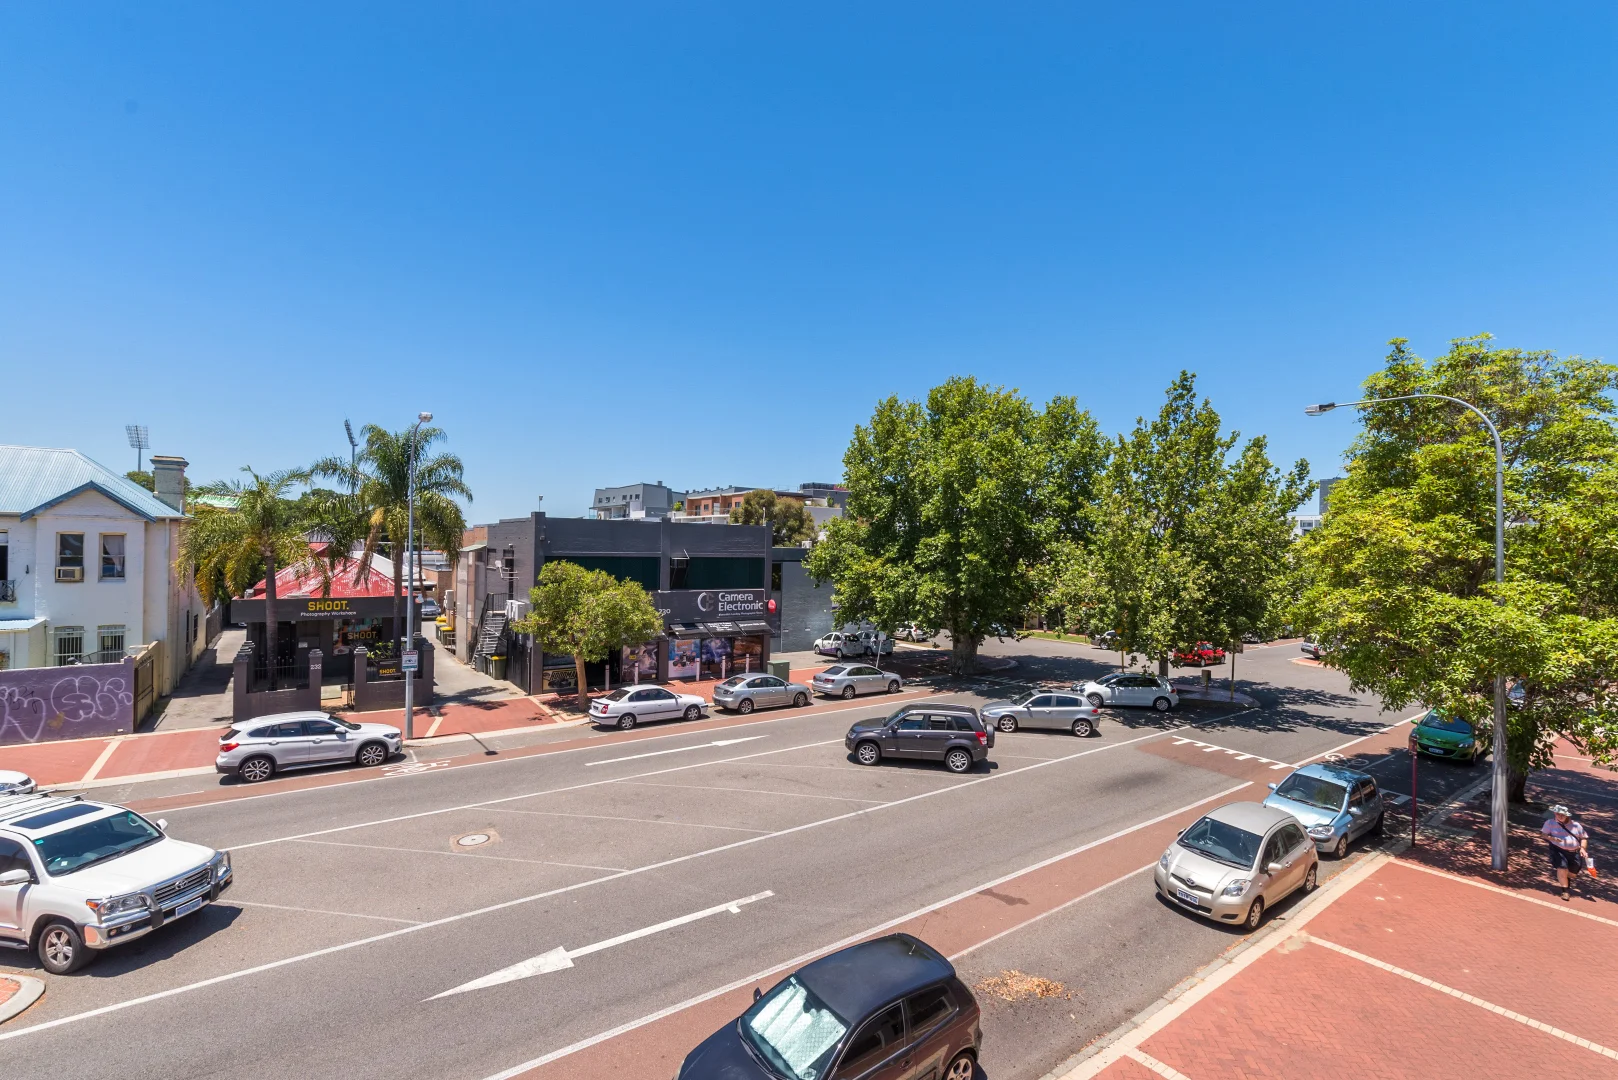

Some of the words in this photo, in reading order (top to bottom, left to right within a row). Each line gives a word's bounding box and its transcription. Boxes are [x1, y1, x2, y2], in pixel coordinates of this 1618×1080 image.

[718, 592, 754, 601] Camera
[308, 601, 349, 610] SHOOT.
[718, 600, 764, 611] Electronic
